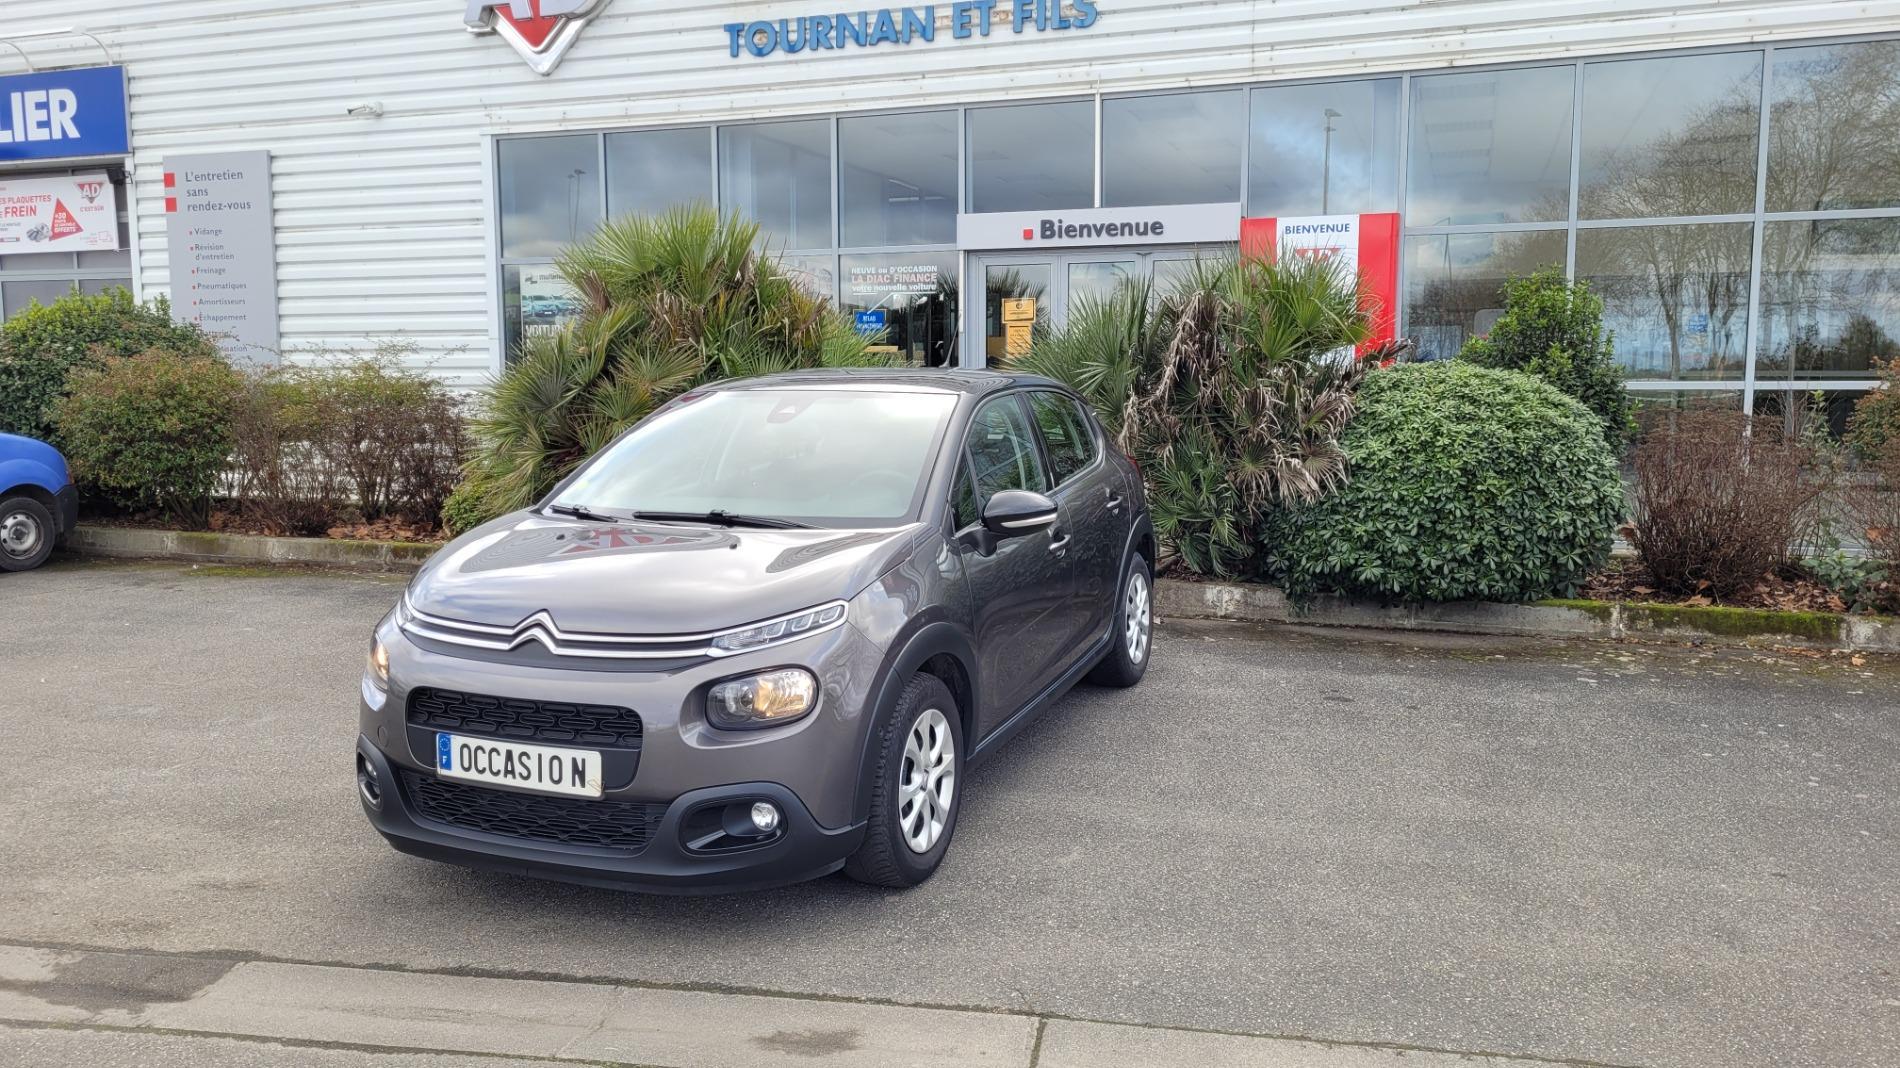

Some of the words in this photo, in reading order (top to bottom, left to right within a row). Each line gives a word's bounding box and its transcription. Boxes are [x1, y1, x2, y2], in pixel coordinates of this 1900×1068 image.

[724, 5, 935, 58] TOURNAN
[952, 1, 996, 39] ET
[1012, 0, 1099, 33] FILS
[185, 169, 244, 182] L'entretien
[81, 183, 101, 199] AD
[186, 188, 209, 197] sans
[8, 195, 52, 205] PLAQUETTES
[4, 205, 37, 218] FREIN
[187, 201, 252, 212] rendez-vous
[194, 228, 223, 236] Vidange
[1040, 219, 1164, 239] Bienvenue
[1284, 223, 1351, 234] BIENVENUE
[195, 252, 235, 260] d'entretien
[196, 267, 226, 275] Freinage
[890, 265, 938, 273] D'OCCASION
[852, 275, 864, 283] LA
[866, 274, 890, 283] DIAC
[893, 273, 938, 282] FINANCE
[197, 282, 247, 291] Pneumatiques
[852, 284, 873, 292] votre
[874, 283, 907, 291] nouvelle
[908, 282, 937, 291] voiture
[199, 298, 246, 306] Amortisseurs
[442, 755, 448, 764] F
[459, 743, 586, 789] OCCASION
